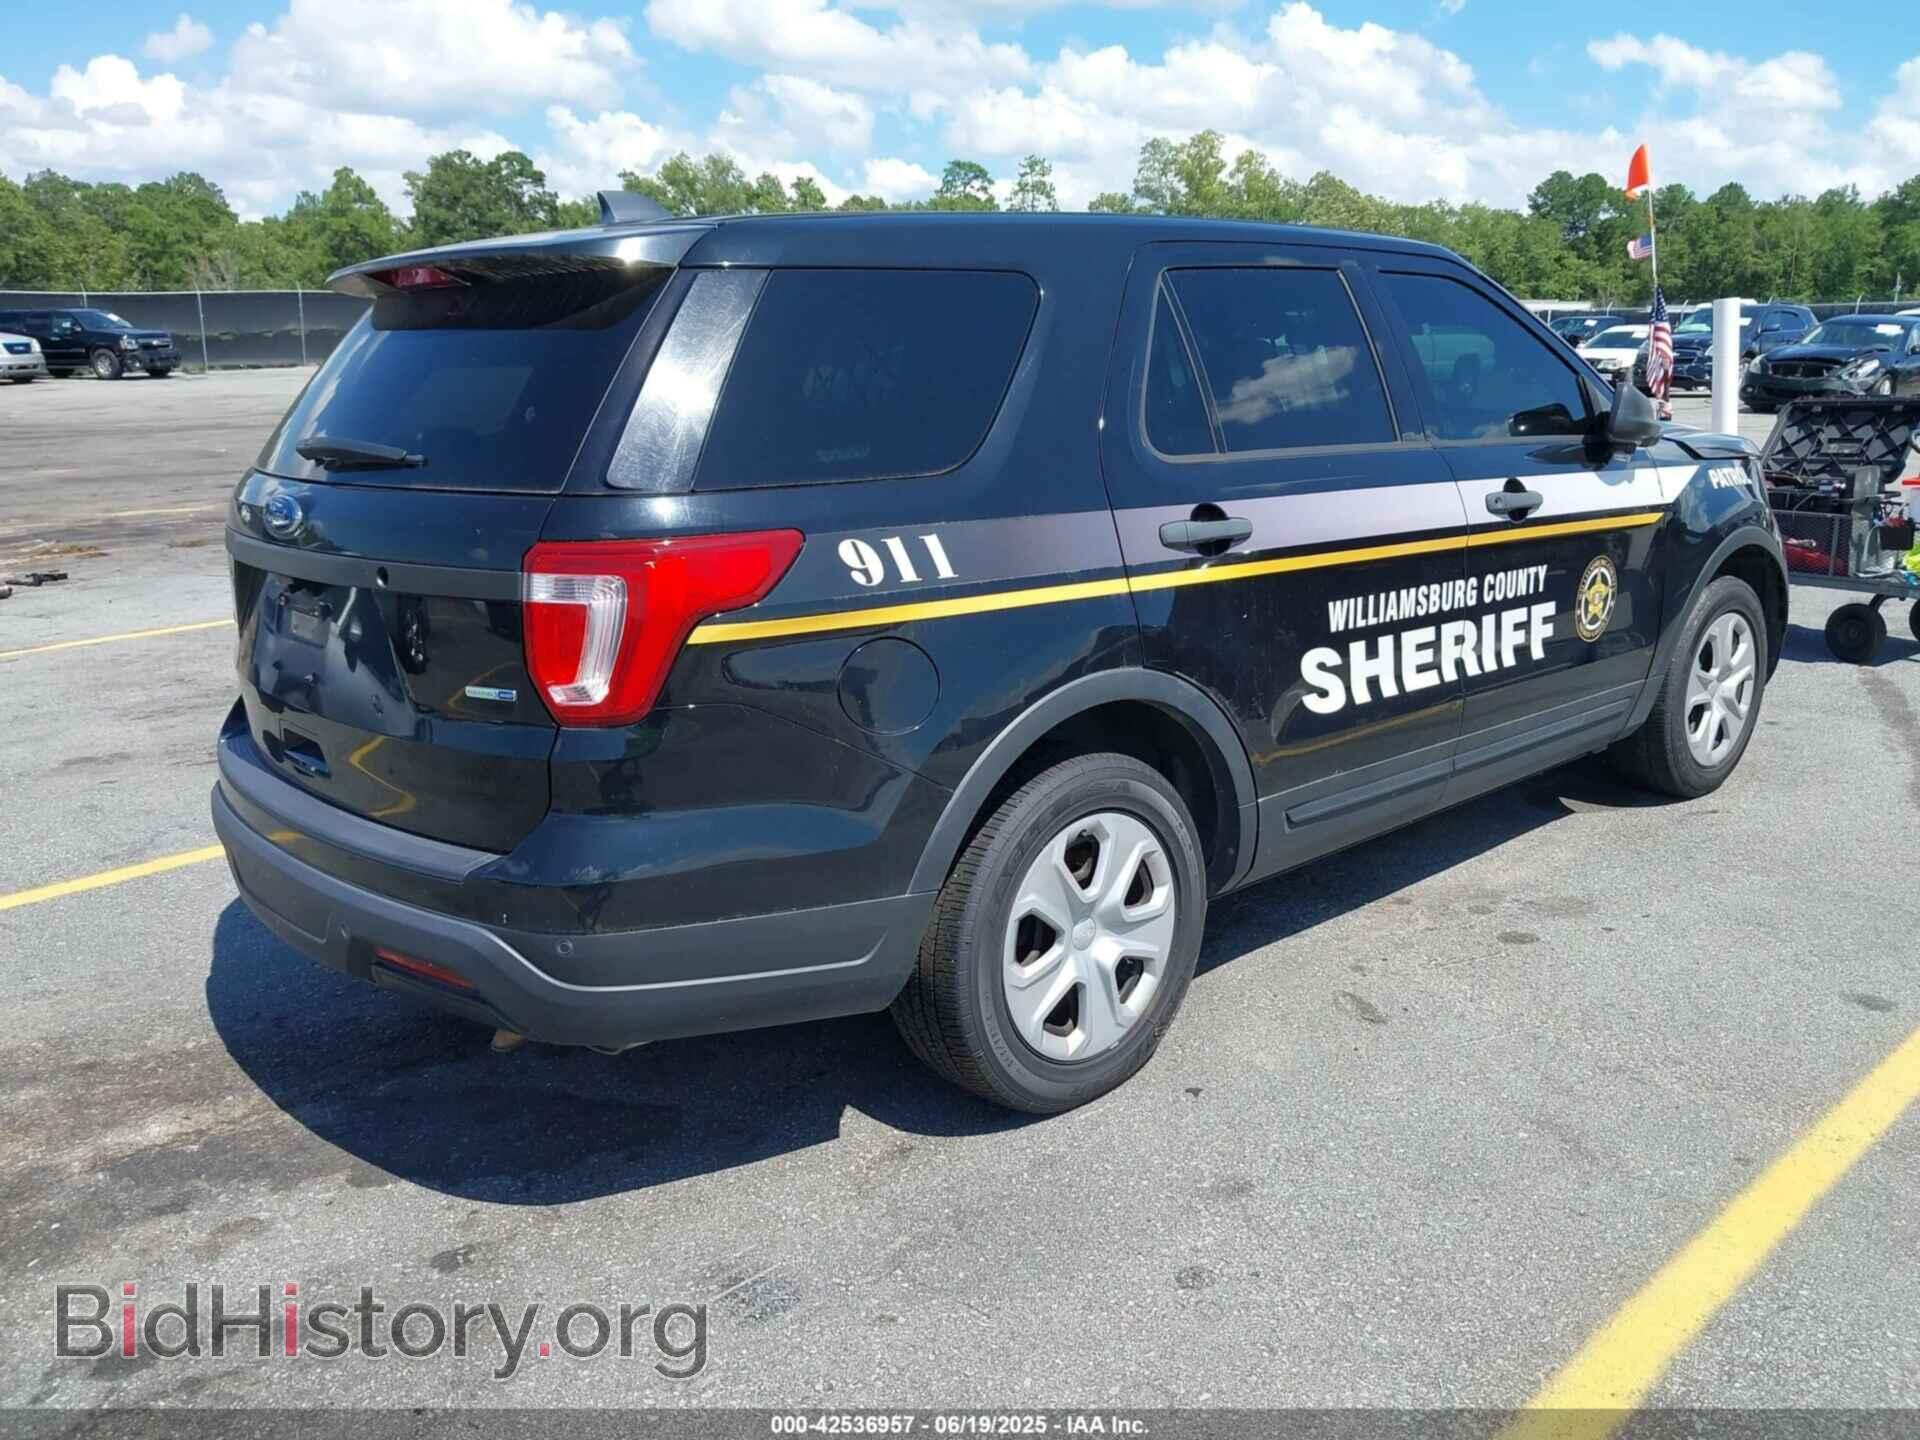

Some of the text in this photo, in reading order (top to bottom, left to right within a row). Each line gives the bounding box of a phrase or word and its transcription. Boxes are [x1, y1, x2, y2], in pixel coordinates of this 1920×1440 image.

[838, 533, 959, 586] 911
[1328, 581, 1477, 633] WILLIAMSBURG
[1483, 564, 1548, 603] COUNTY
[1300, 600, 1557, 714] SHERIFF
